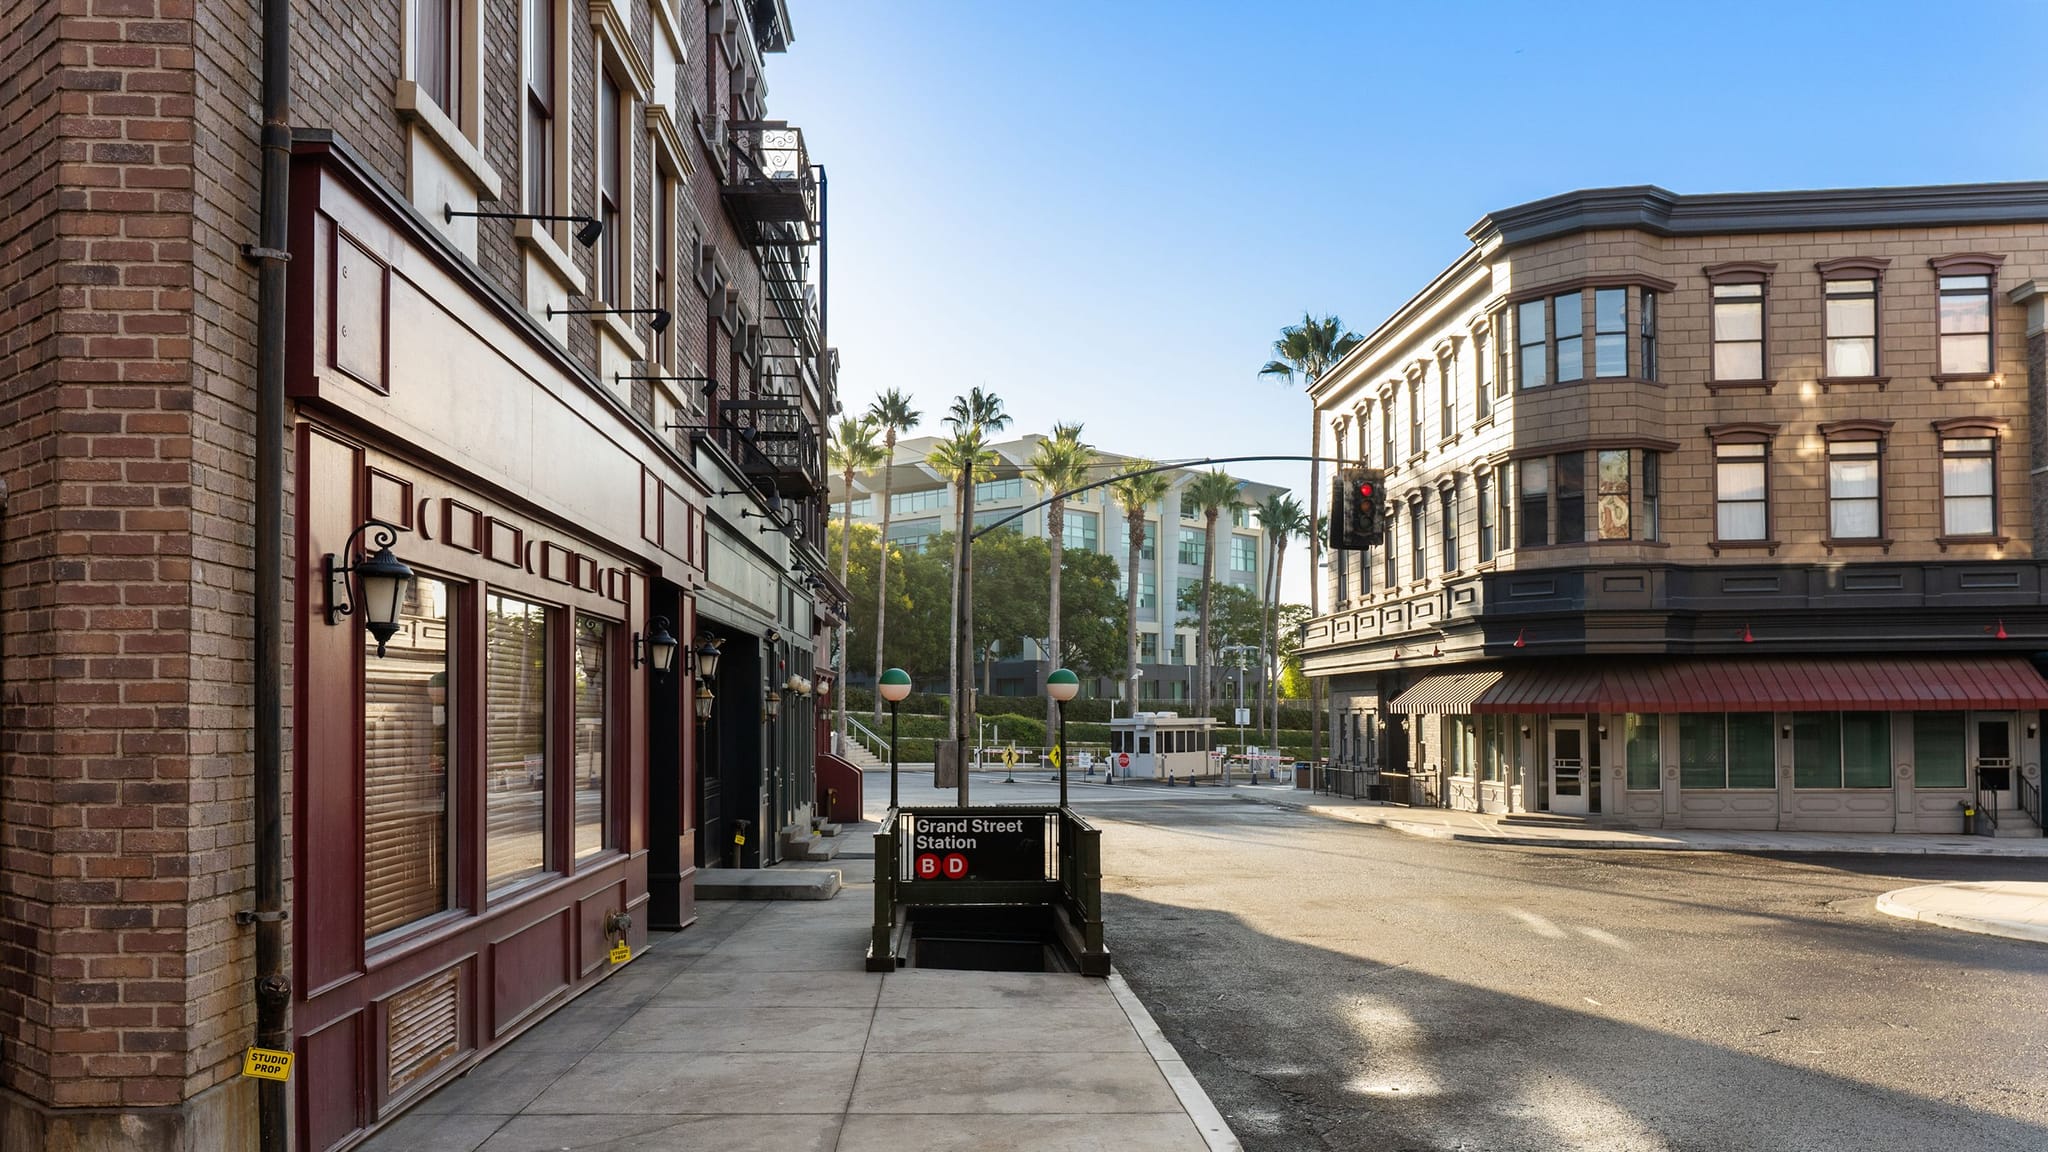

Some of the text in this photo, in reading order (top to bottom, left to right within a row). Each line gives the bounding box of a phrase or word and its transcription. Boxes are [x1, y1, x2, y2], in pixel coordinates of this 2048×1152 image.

[917, 819, 1023, 833] Grand Street
[917, 835, 977, 849] Station
[922, 858, 963, 873] B D
[251, 1053, 288, 1065] STUDIO
[254, 1064, 281, 1074] PROP
